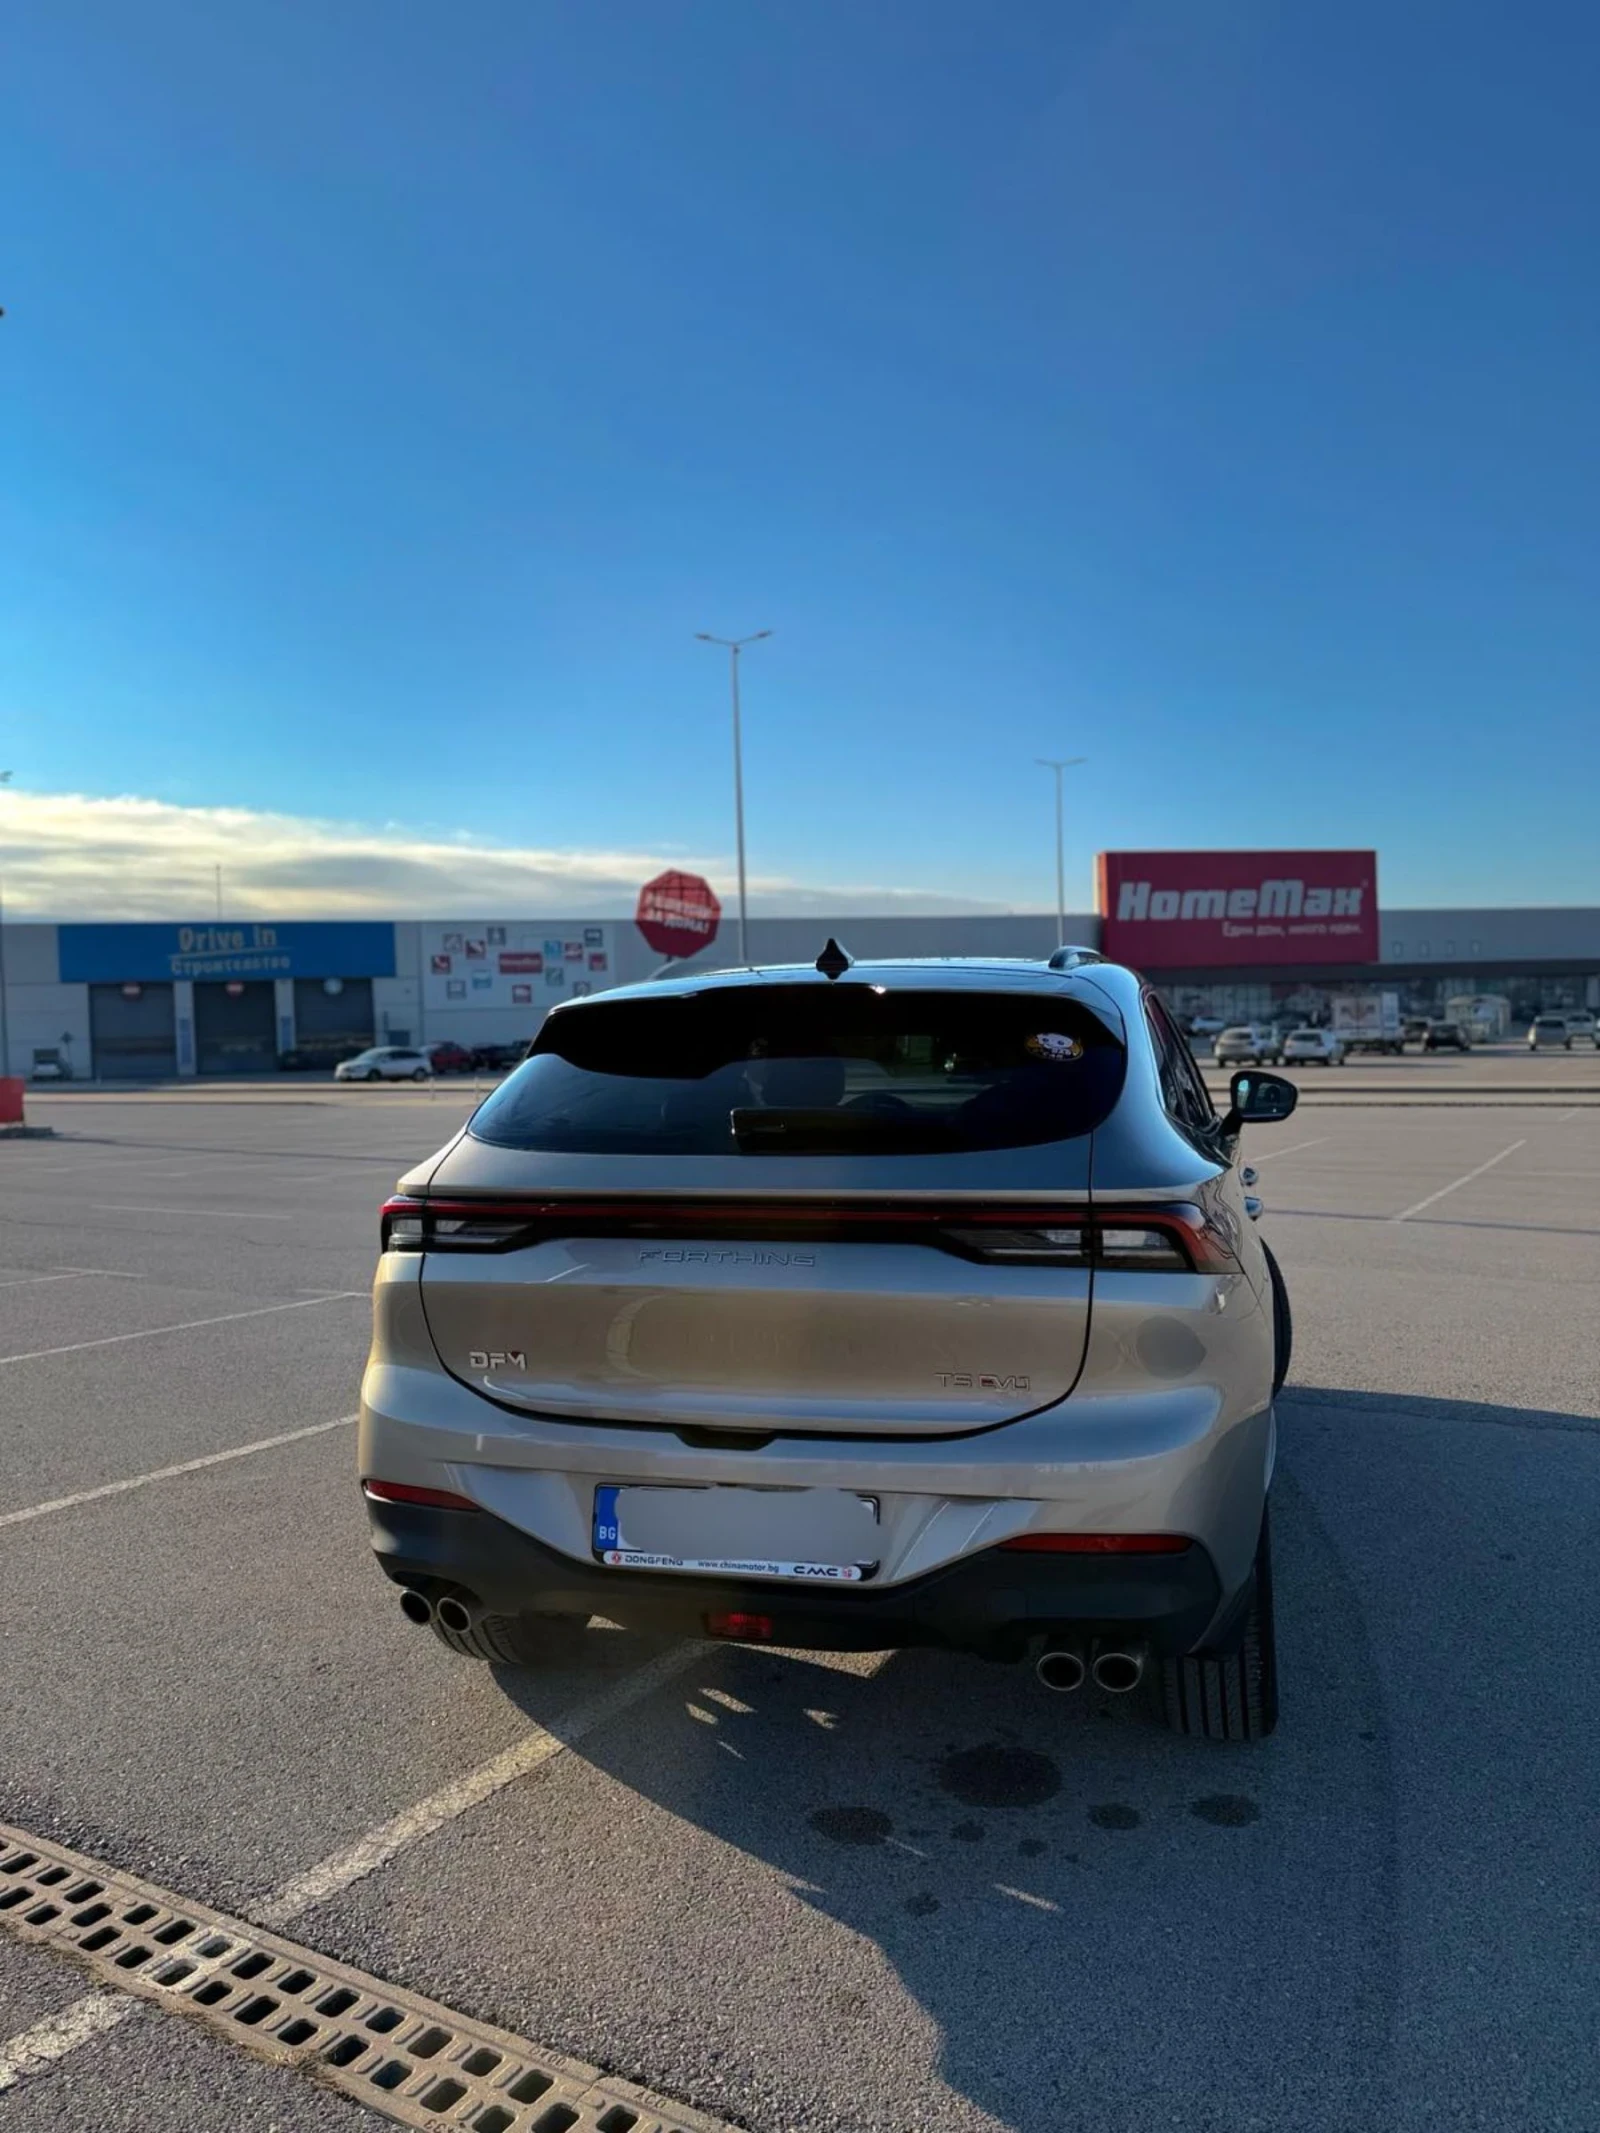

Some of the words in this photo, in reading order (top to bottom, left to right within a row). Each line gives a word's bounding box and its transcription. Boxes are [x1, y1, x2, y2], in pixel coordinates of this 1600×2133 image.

[1117, 880, 1362, 921] HomeMax
[178, 926, 244, 951] Drive
[254, 925, 277, 947] In
[639, 1248, 817, 1267] FORTHING
[468, 1350, 527, 1372] DFM
[598, 1525, 617, 1541] BG
[624, 1554, 684, 1567] DONGFENG
[697, 1558, 780, 1574] www.chinamotor.bg
[793, 1564, 839, 1577] CMC
